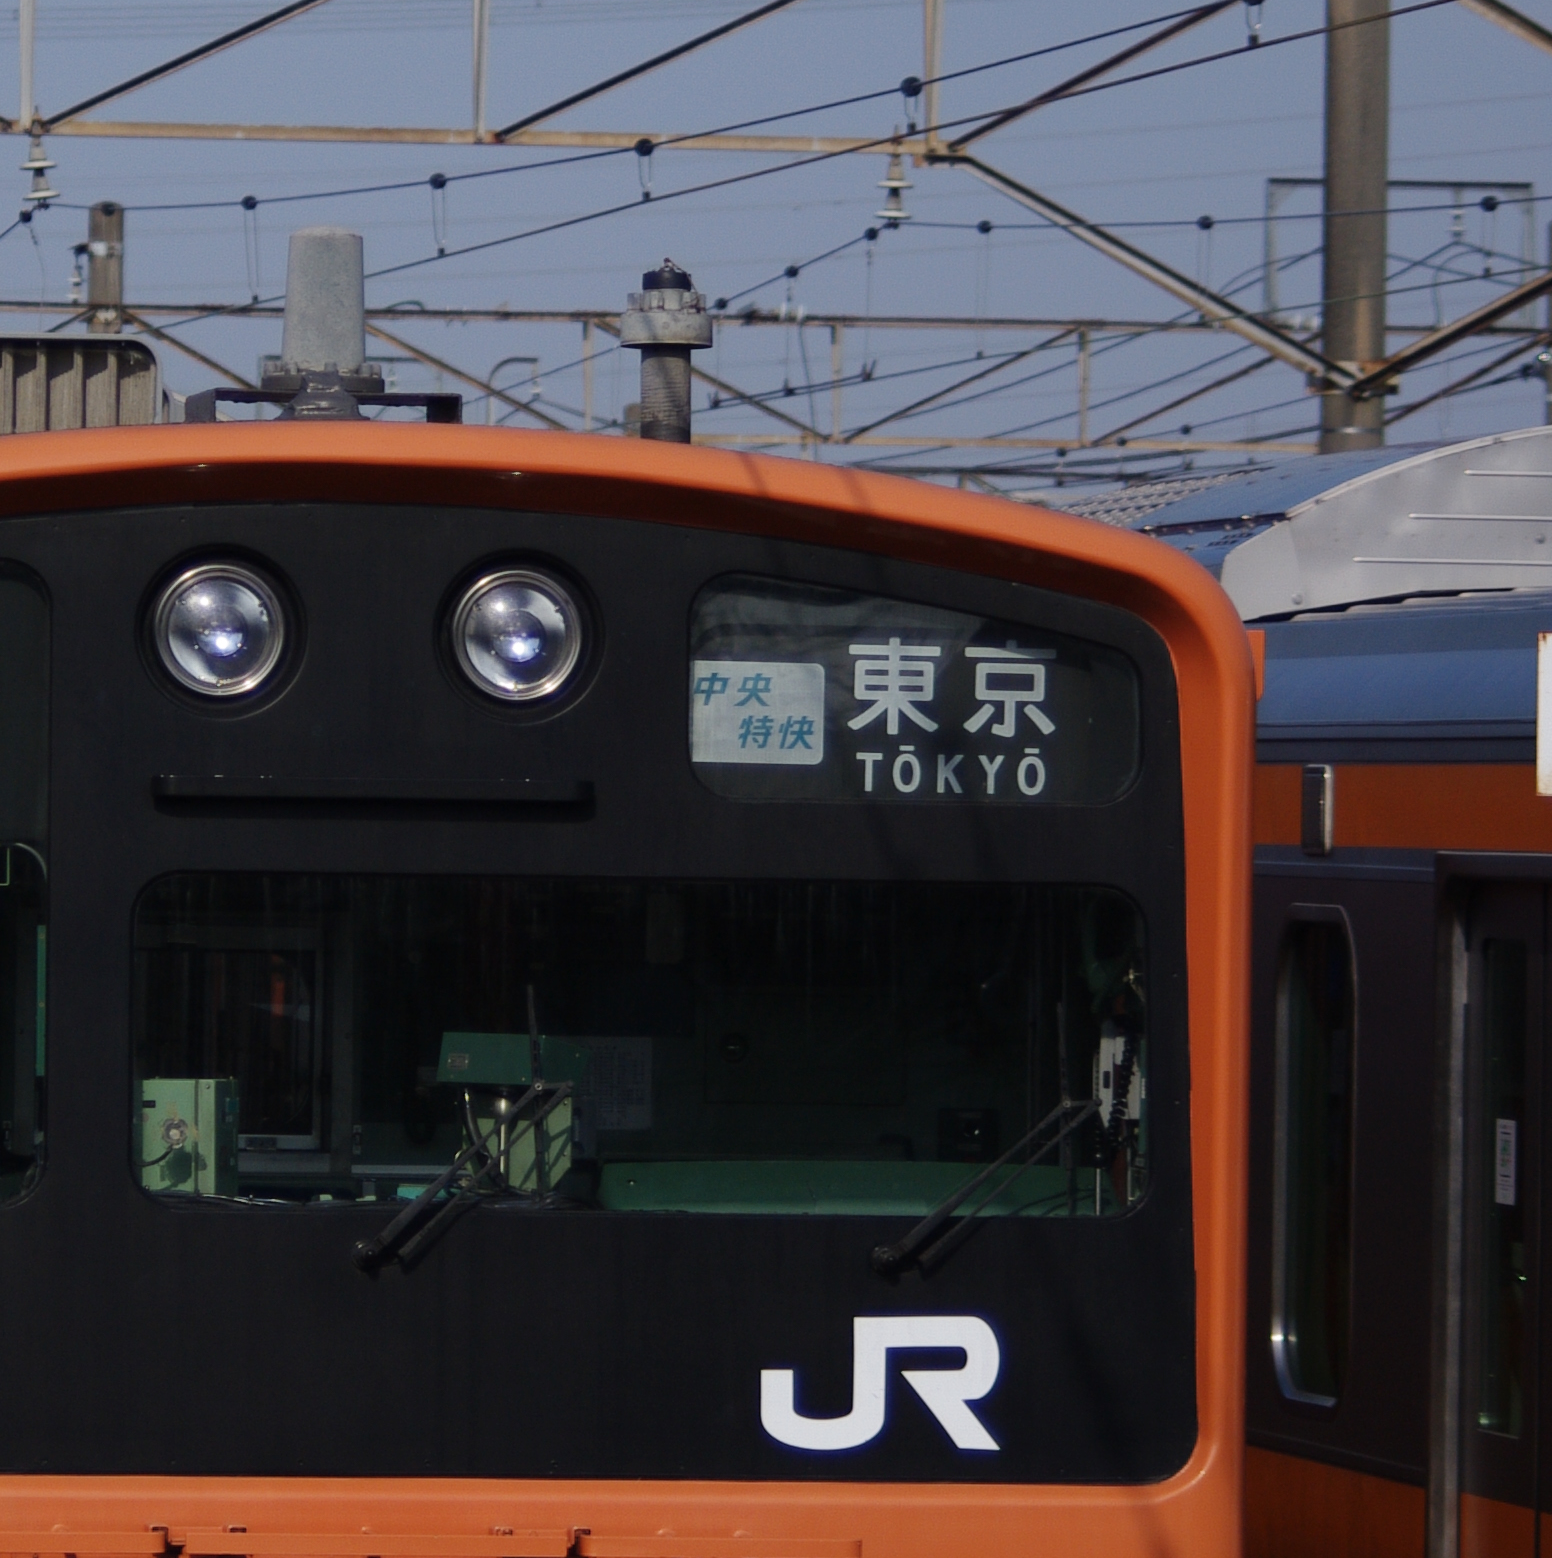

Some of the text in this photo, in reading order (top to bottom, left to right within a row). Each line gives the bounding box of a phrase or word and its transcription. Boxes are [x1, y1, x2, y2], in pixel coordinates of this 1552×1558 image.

[693, 672, 773, 707] 中央
[847, 637, 1057, 738] 東京
[738, 715, 815, 750] 特快
[855, 745, 1046, 795] TŌKYŌ
[760, 1315, 1001, 1451] JR
